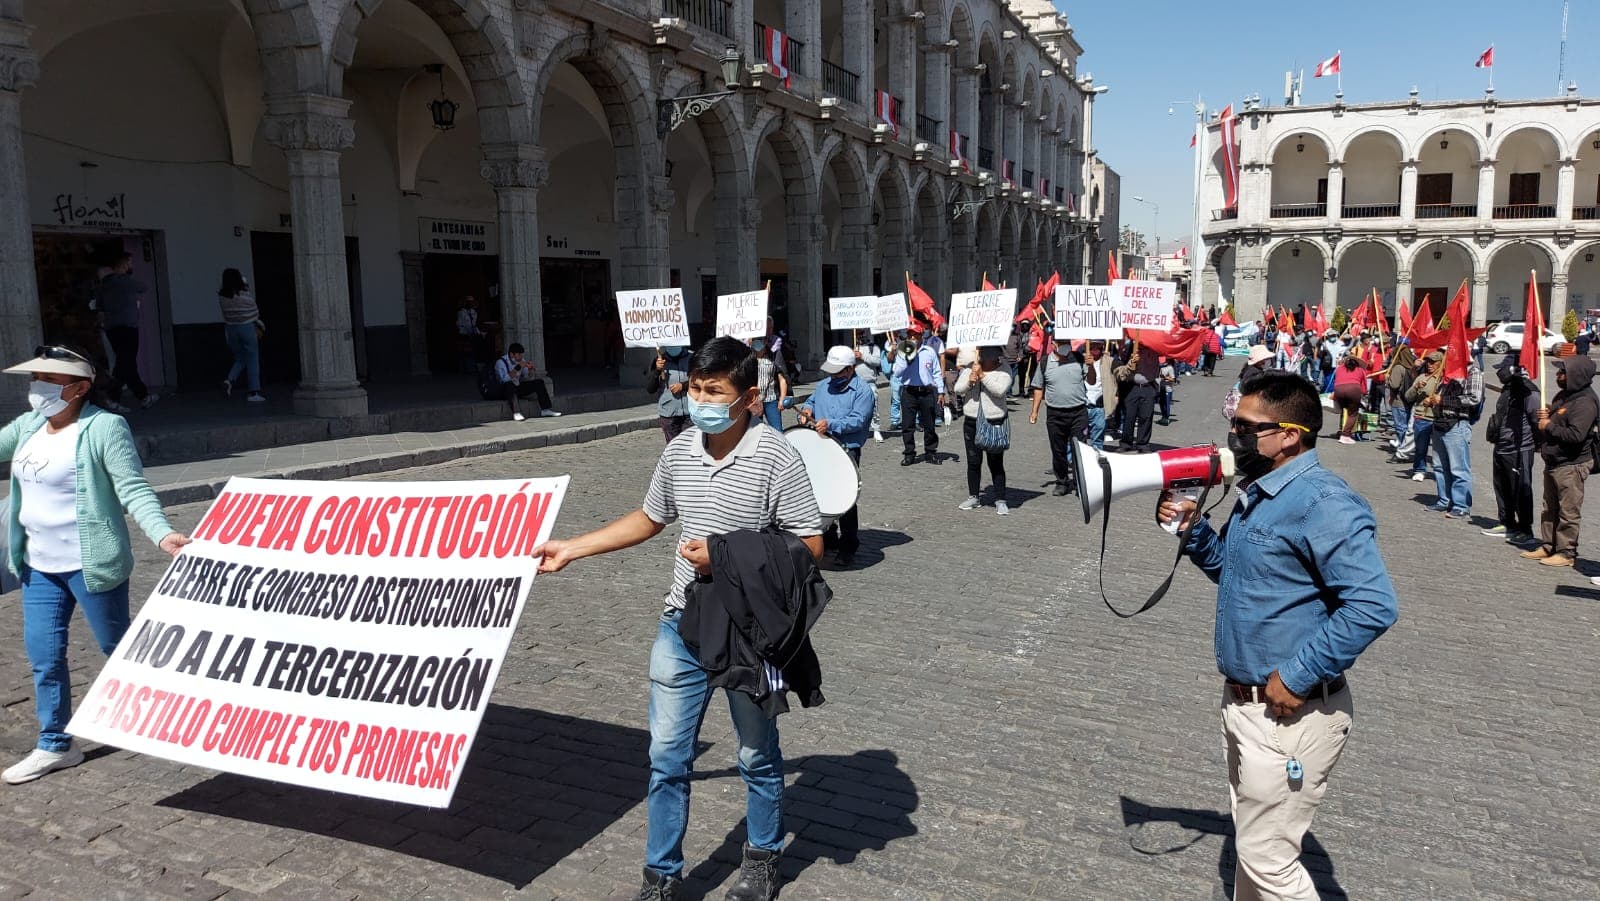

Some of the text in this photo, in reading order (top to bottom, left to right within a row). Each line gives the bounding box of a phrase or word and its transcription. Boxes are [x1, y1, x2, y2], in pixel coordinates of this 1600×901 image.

[632, 293, 681, 308] NO A LOS
[727, 293, 759, 309] MUERTE
[965, 293, 1002, 309] CIERRE
[1068, 288, 1110, 306] NUEVA
[1124, 286, 1163, 299] CIERRE
[1131, 300, 1148, 309] DEL
[624, 307, 682, 324] MONOPOLIOS
[735, 309, 745, 319] AL
[1056, 306, 1122, 329] CONSTITUCIÓN
[624, 324, 688, 341] COMERCIAL
[955, 325, 1001, 344] URGENTE
[193, 483, 553, 559] NUEVA CONSTITUCIÓN
[158, 553, 523, 630] CIERRE DE CONGRESO OBSTRUCCIONISTA
[122, 619, 493, 712] NO A LA TERCERIZACIÓN
[88, 677, 467, 791] CASTILLO CUMPLE TUS PROMESAS
